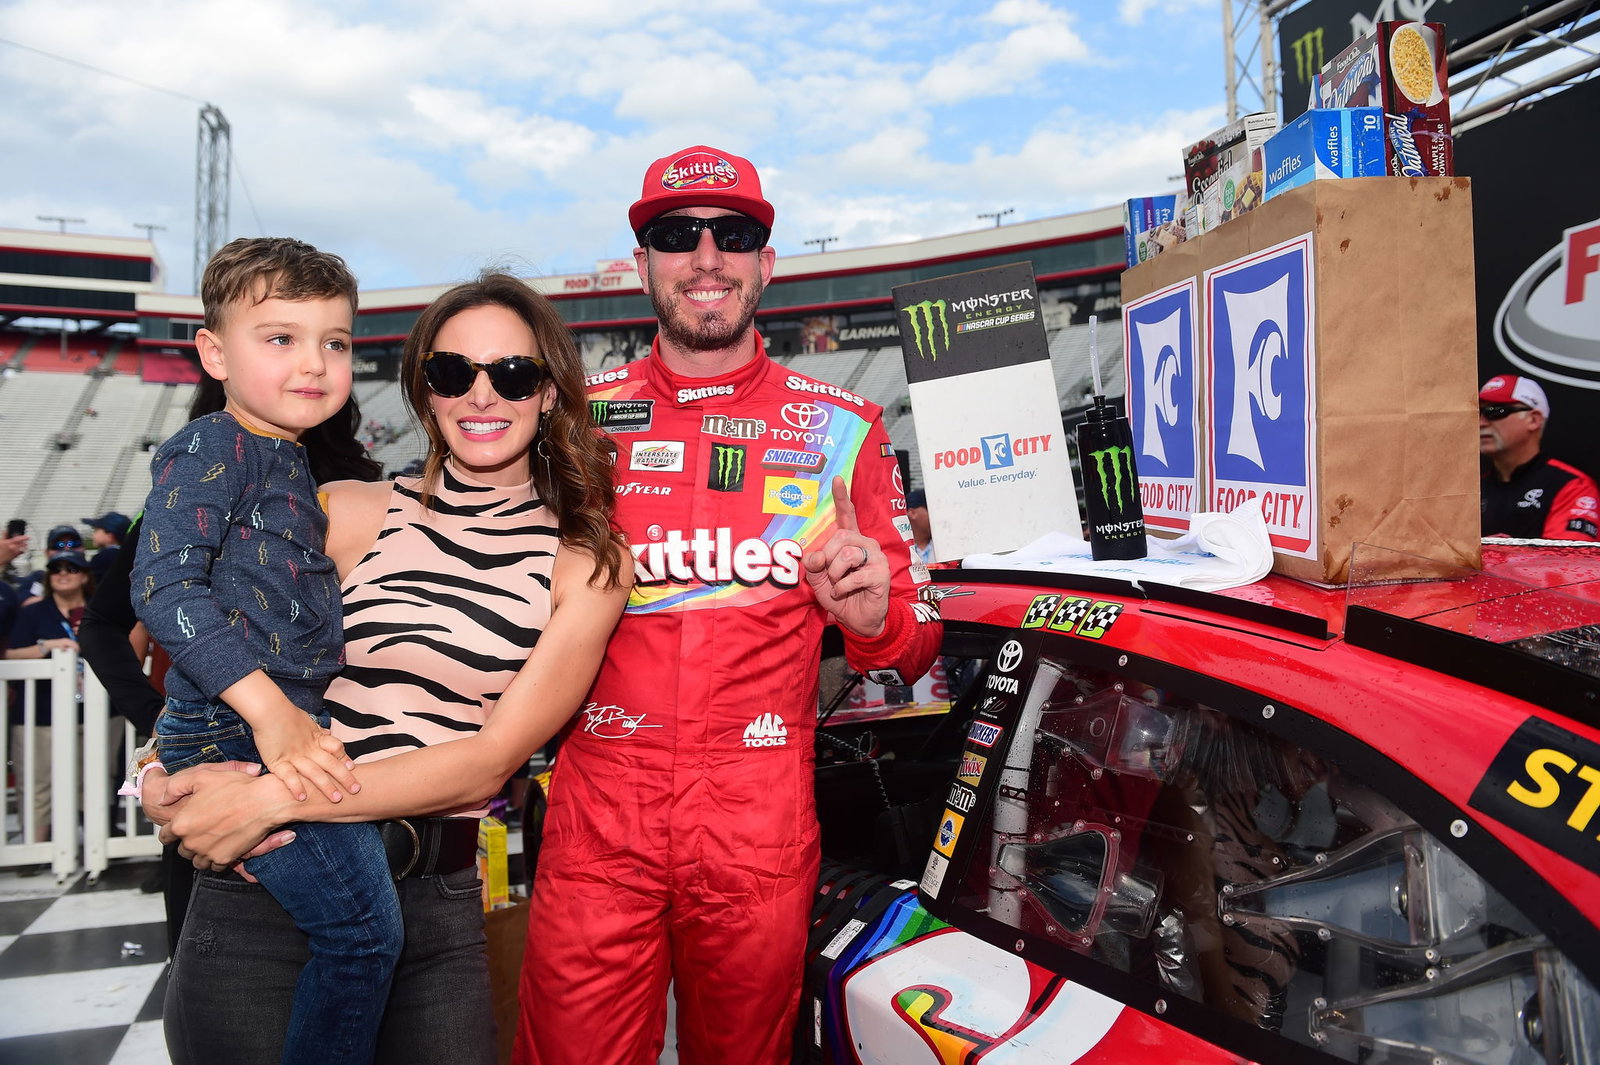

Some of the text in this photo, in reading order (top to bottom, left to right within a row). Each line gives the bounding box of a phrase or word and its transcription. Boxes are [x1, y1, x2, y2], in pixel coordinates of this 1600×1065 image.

[1364, 115, 1377, 132] 10
[1327, 125, 1339, 168] waffles
[1385, 112, 1425, 177] Oatmeal
[667, 162, 735, 184] Skittles
[1269, 154, 1302, 185] waffles
[1438, 153, 1446, 177] ROWN
[1161, 207, 1171, 224] fru
[951, 288, 1034, 313] MONSTER
[965, 304, 1023, 320] ENERGY
[965, 311, 1035, 331] NASCAR CUP SERIES
[676, 384, 735, 404] Skittles
[785, 375, 865, 408] Skittles
[609, 402, 648, 411] MONSTER
[610, 424, 641, 433] CHAMPION
[770, 428, 835, 448] TOYOTA
[635, 451, 679, 459] INTERSTATE
[764, 449, 820, 466] SNICKERS
[934, 446, 982, 471] FOOD
[1012, 433, 1052, 457] CITY
[957, 468, 1037, 489] Value. Everyday.
[769, 489, 813, 502] Pedigree
[1138, 482, 1193, 513] FOOD CITY
[1261, 490, 1304, 529] CITY
[1095, 519, 1144, 535] MONSTE
[986, 674, 1019, 695] TOYOTA
[743, 712, 788, 738] MAC
[742, 737, 787, 748] TOOLS
[1506, 748, 1600, 842] ST
